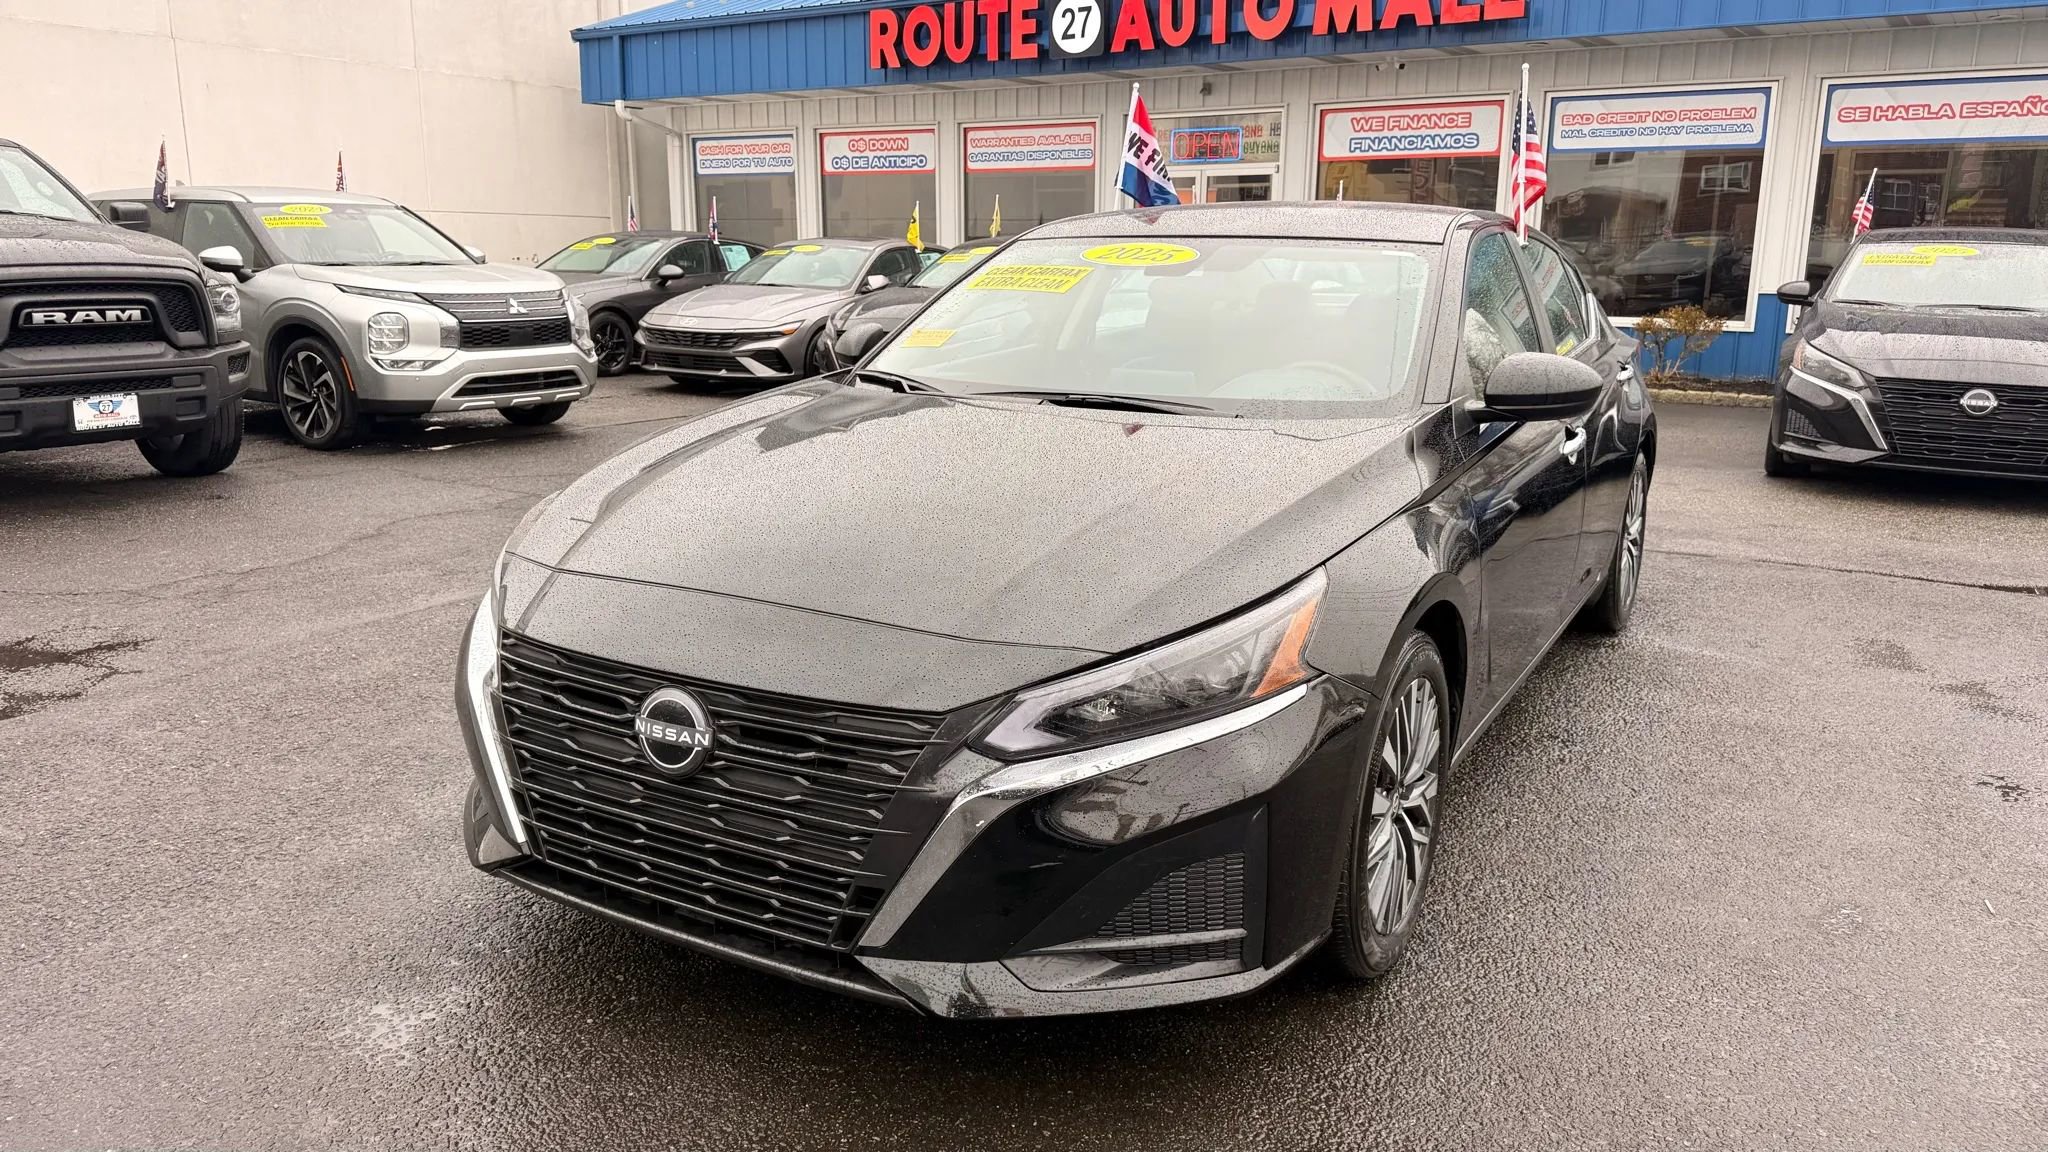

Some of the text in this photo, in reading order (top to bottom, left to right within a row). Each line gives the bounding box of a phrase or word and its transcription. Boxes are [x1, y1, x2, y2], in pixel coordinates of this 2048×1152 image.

[870, 0, 1038, 68] ROUTE
[1061, 6, 1093, 41] 27
[1110, 0, 1294, 52] AUTO
[1562, 107, 1757, 127] BAD CREDIT NO PROBLEM
[1837, 106, 1871, 123] SE
[1873, 103, 1955, 121] HABLA
[1351, 112, 1472, 132] WE FINANCE
[1561, 124, 1753, 139] MAL CREDITO NO HAY PROBLEMA
[869, 138, 909, 151] DOWN
[971, 133, 1092, 148] WARRANTIES AVAILABLE
[1173, 132, 1239, 159] OPEN
[1243, 140, 1279, 155] GUYANA
[1349, 132, 1479, 153] FINANCIAMOS
[699, 142, 791, 155] CASH FOR YOUR CAR
[969, 149, 1093, 162] GARANTIAS DISPONIBLES
[700, 157, 793, 169] DINERO POR TU AUTO
[851, 156, 870, 168] DE
[871, 154, 928, 168] ANTICIPO
[1098, 247, 1178, 262] 2025
[985, 266, 1089, 278] CLEAN CARFAX
[974, 276, 1071, 289] EXTRA CLEAN
[31, 309, 142, 325] RAM
[635, 718, 710, 746] NISSAN
